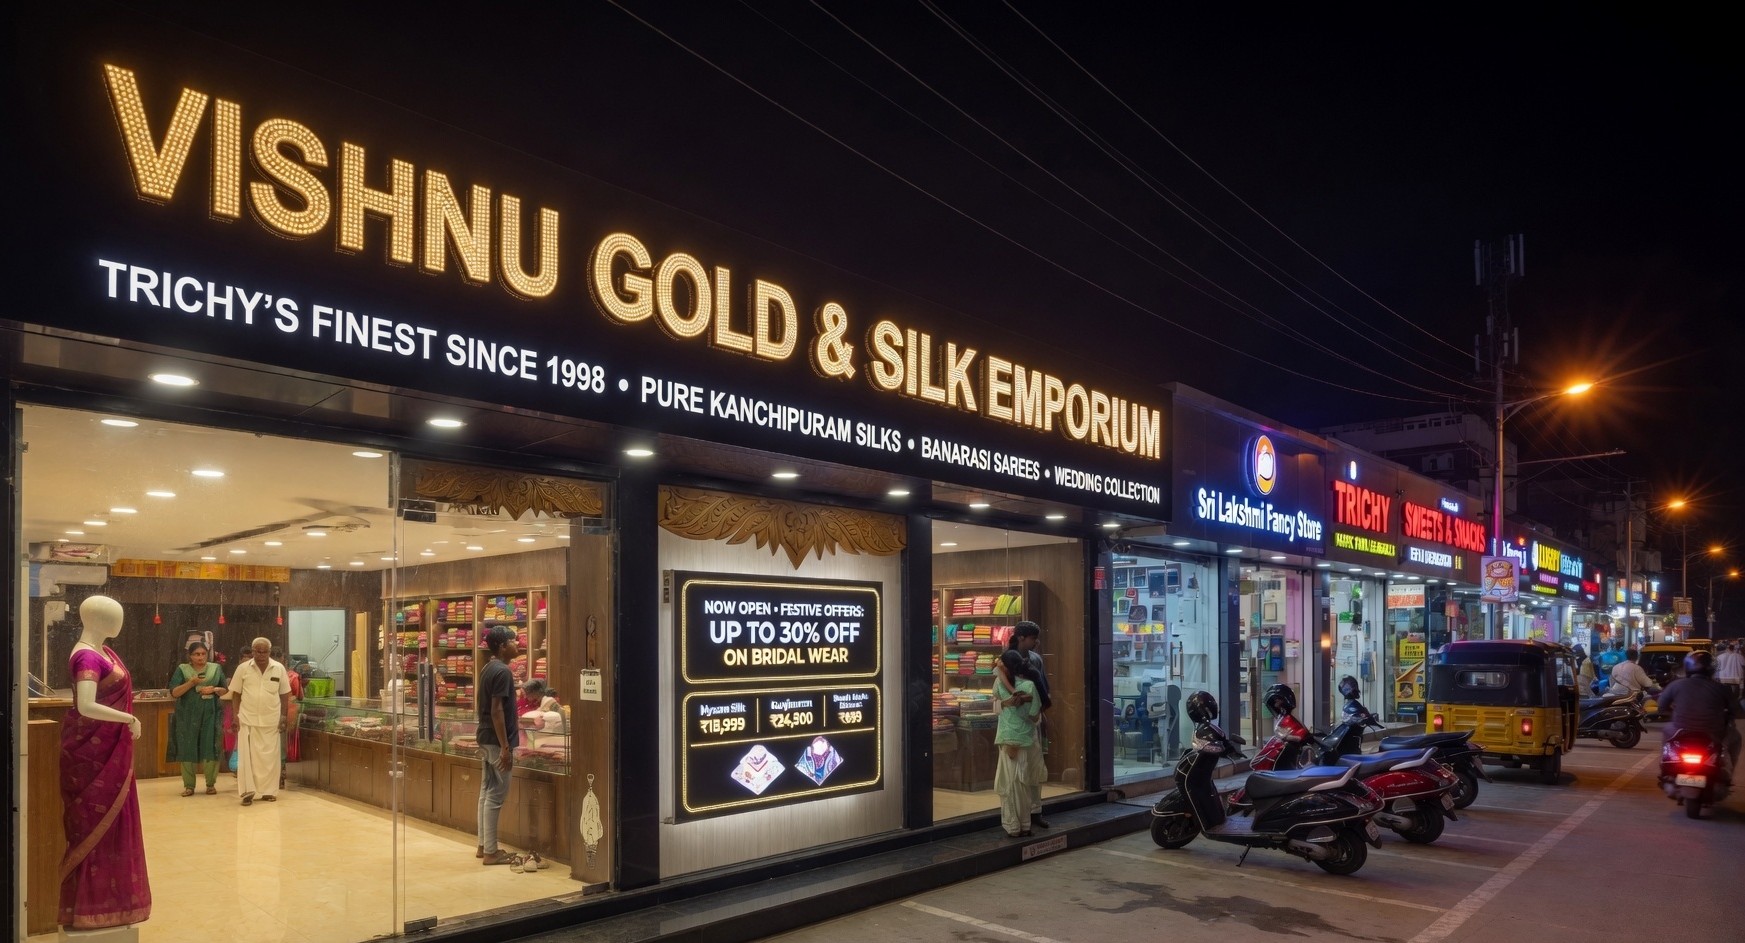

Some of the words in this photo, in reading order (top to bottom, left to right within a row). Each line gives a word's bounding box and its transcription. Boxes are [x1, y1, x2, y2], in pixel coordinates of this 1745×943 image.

[104, 63, 559, 297] VISHNU
[594, 232, 798, 360] GOLD
[816, 302, 855, 379] &
[871, 320, 978, 412] SILK
[988, 354, 1161, 459] EMPORIUM
[98, 258, 299, 333] TRICHY’S
[312, 304, 437, 359] FINEST
[446, 334, 538, 381] SINCE
[546, 355, 605, 394] 1998
[641, 376, 704, 414] PURE
[710, 390, 851, 443] KANCHIPURAM
[855, 422, 902, 453] SILKS
[921, 436, 991, 471] BANARASI
[993, 452, 1041, 481] SAREES
[1054, 465, 1102, 494] WEDDING
[1103, 476, 1161, 504] COLLECTION
[1198, 487, 1216, 521] Sri
[1218, 491, 1265, 530] Lakshmi
[1266, 503, 1296, 542] Fancy
[1297, 510, 1322, 541] Store
[1335, 480, 1391, 533] TRICHY
[704, 600, 736, 615] NOW
[739, 601, 772, 616] OPEN
[780, 602, 823, 617] FESTIVE
[824, 604, 865, 618] OFFERS:
[709, 620, 742, 644] UP
[746, 620, 776, 644] TO
[779, 621, 820, 644] 30%
[824, 621, 860, 644] OFF
[723, 648, 748, 666] ON
[752, 648, 806, 665] BRIDAL
[808, 647, 849, 664] WEAR
